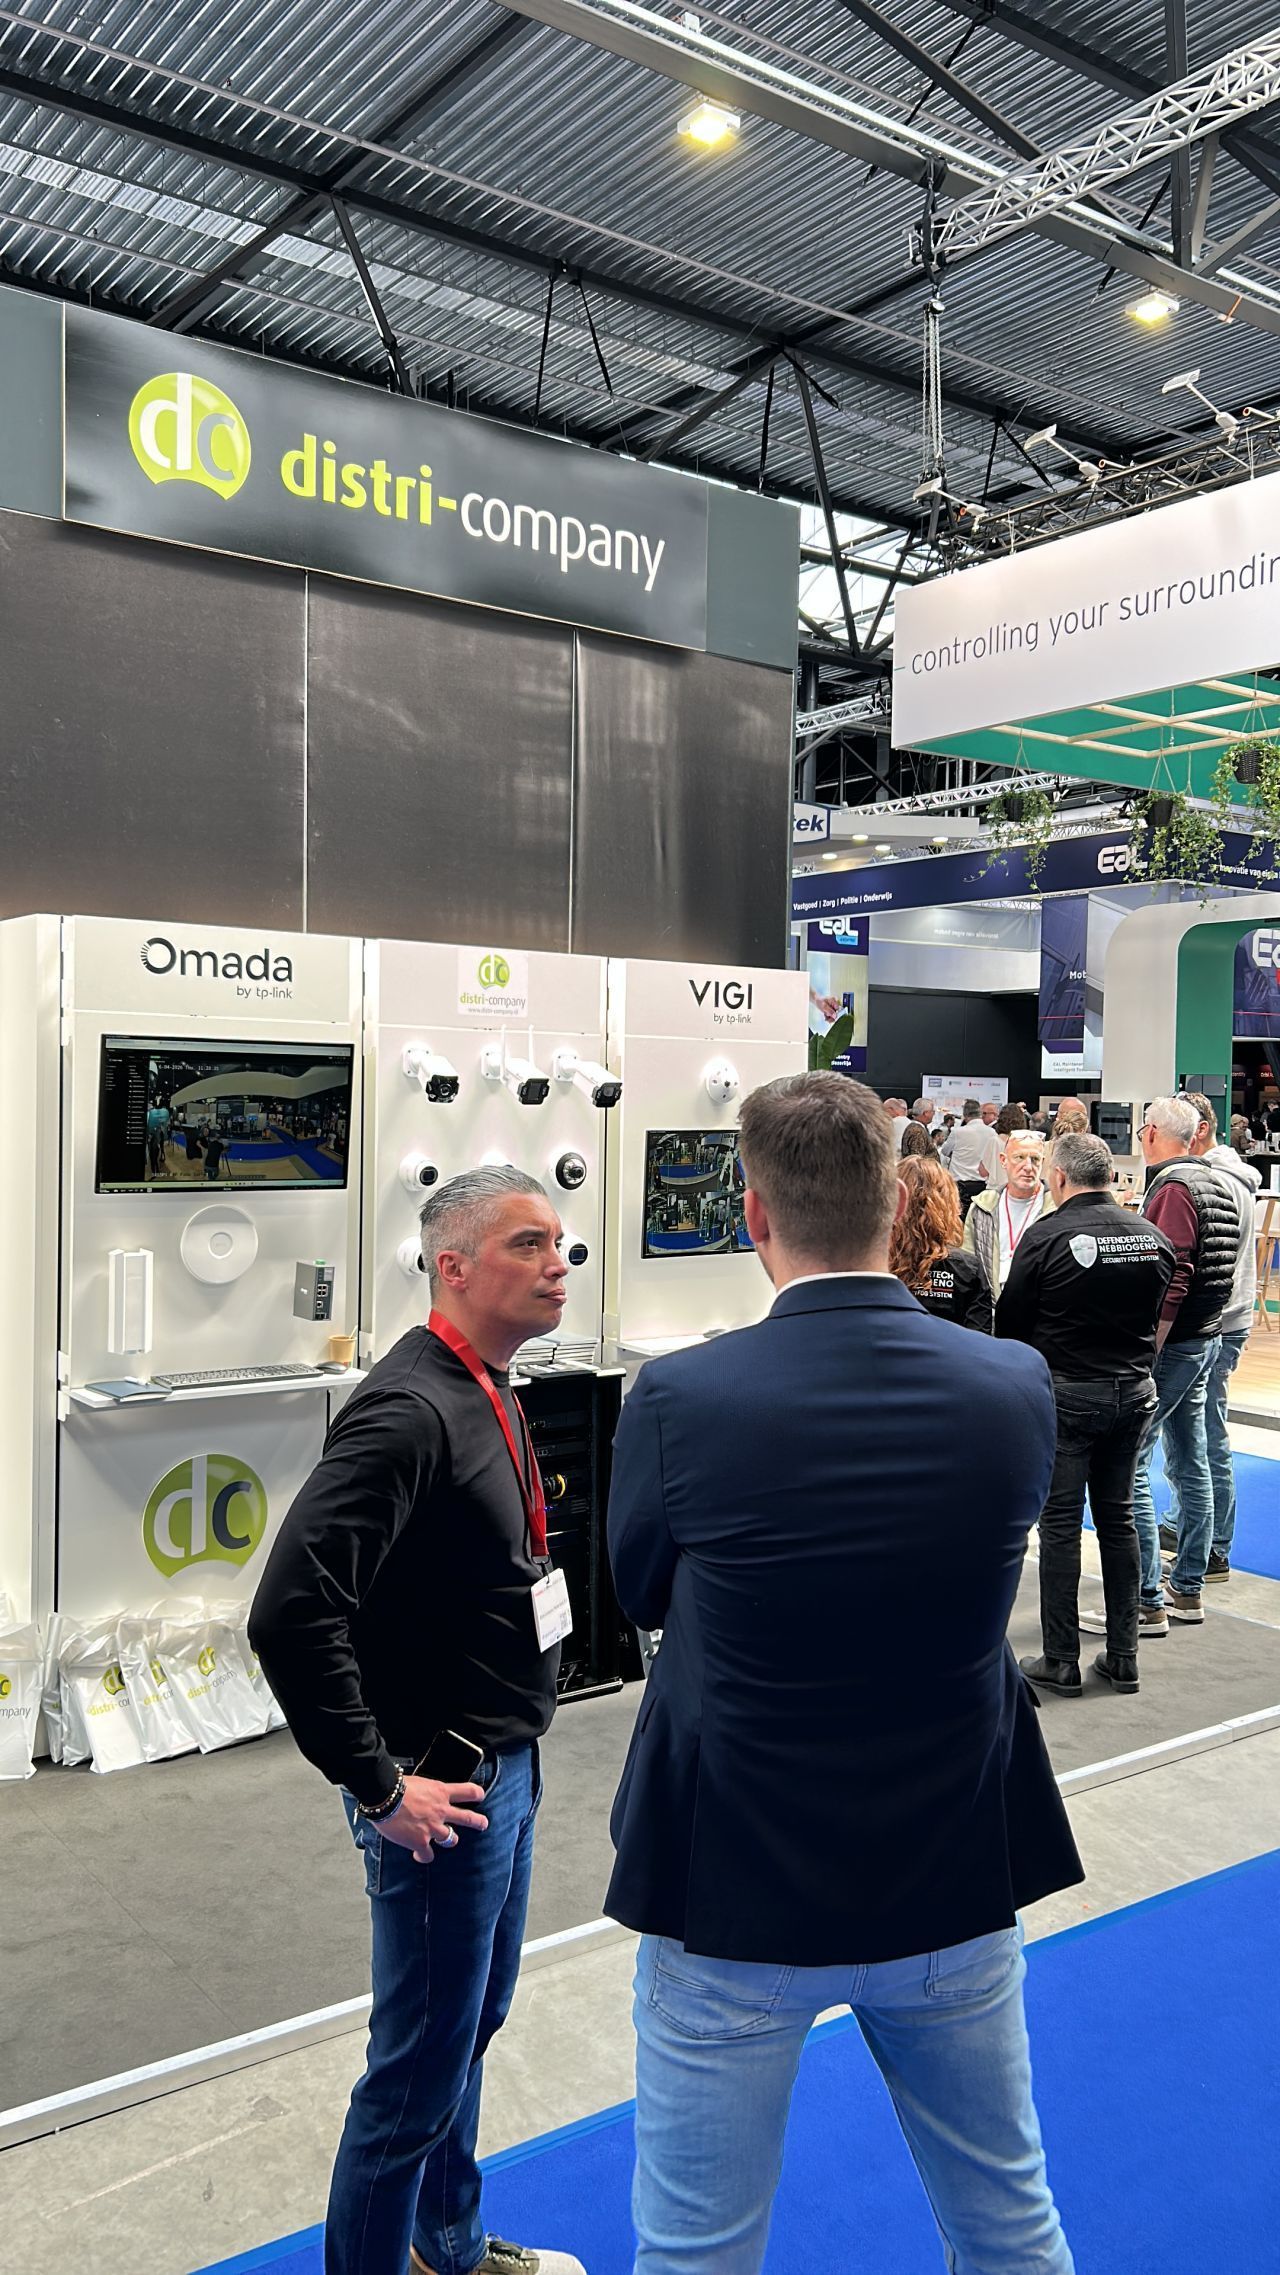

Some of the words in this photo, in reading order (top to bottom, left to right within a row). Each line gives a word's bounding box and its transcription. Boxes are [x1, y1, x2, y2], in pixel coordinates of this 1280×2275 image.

[280, 432, 666, 592] distri-company
[912, 621, 1039, 675] controlling
[1049, 601, 1109, 646] your
[793, 814, 825, 832] ek
[793, 900, 818, 911] Vastgoed
[822, 899, 836, 908] Zorg
[840, 896, 859, 905] Politie
[863, 891, 893, 903] Onderwijs
[140, 937, 293, 983] Omada
[236, 985, 252, 999] by
[256, 986, 293, 1000] tp-link
[459, 992, 526, 1010] distri-company
[688, 979, 753, 1010] VIGI
[713, 1013, 724, 1025] by
[726, 1014, 752, 1025] tp-link
[1096, 1234, 1156, 1245] DEFENDERTECH
[1099, 1242, 1159, 1253] NEBBIOGENO
[1101, 1256, 1127, 1264] SECURITY
[1140, 1254, 1160, 1262] SYSTEM
[929, 1291, 953, 1299] SYSTEM
